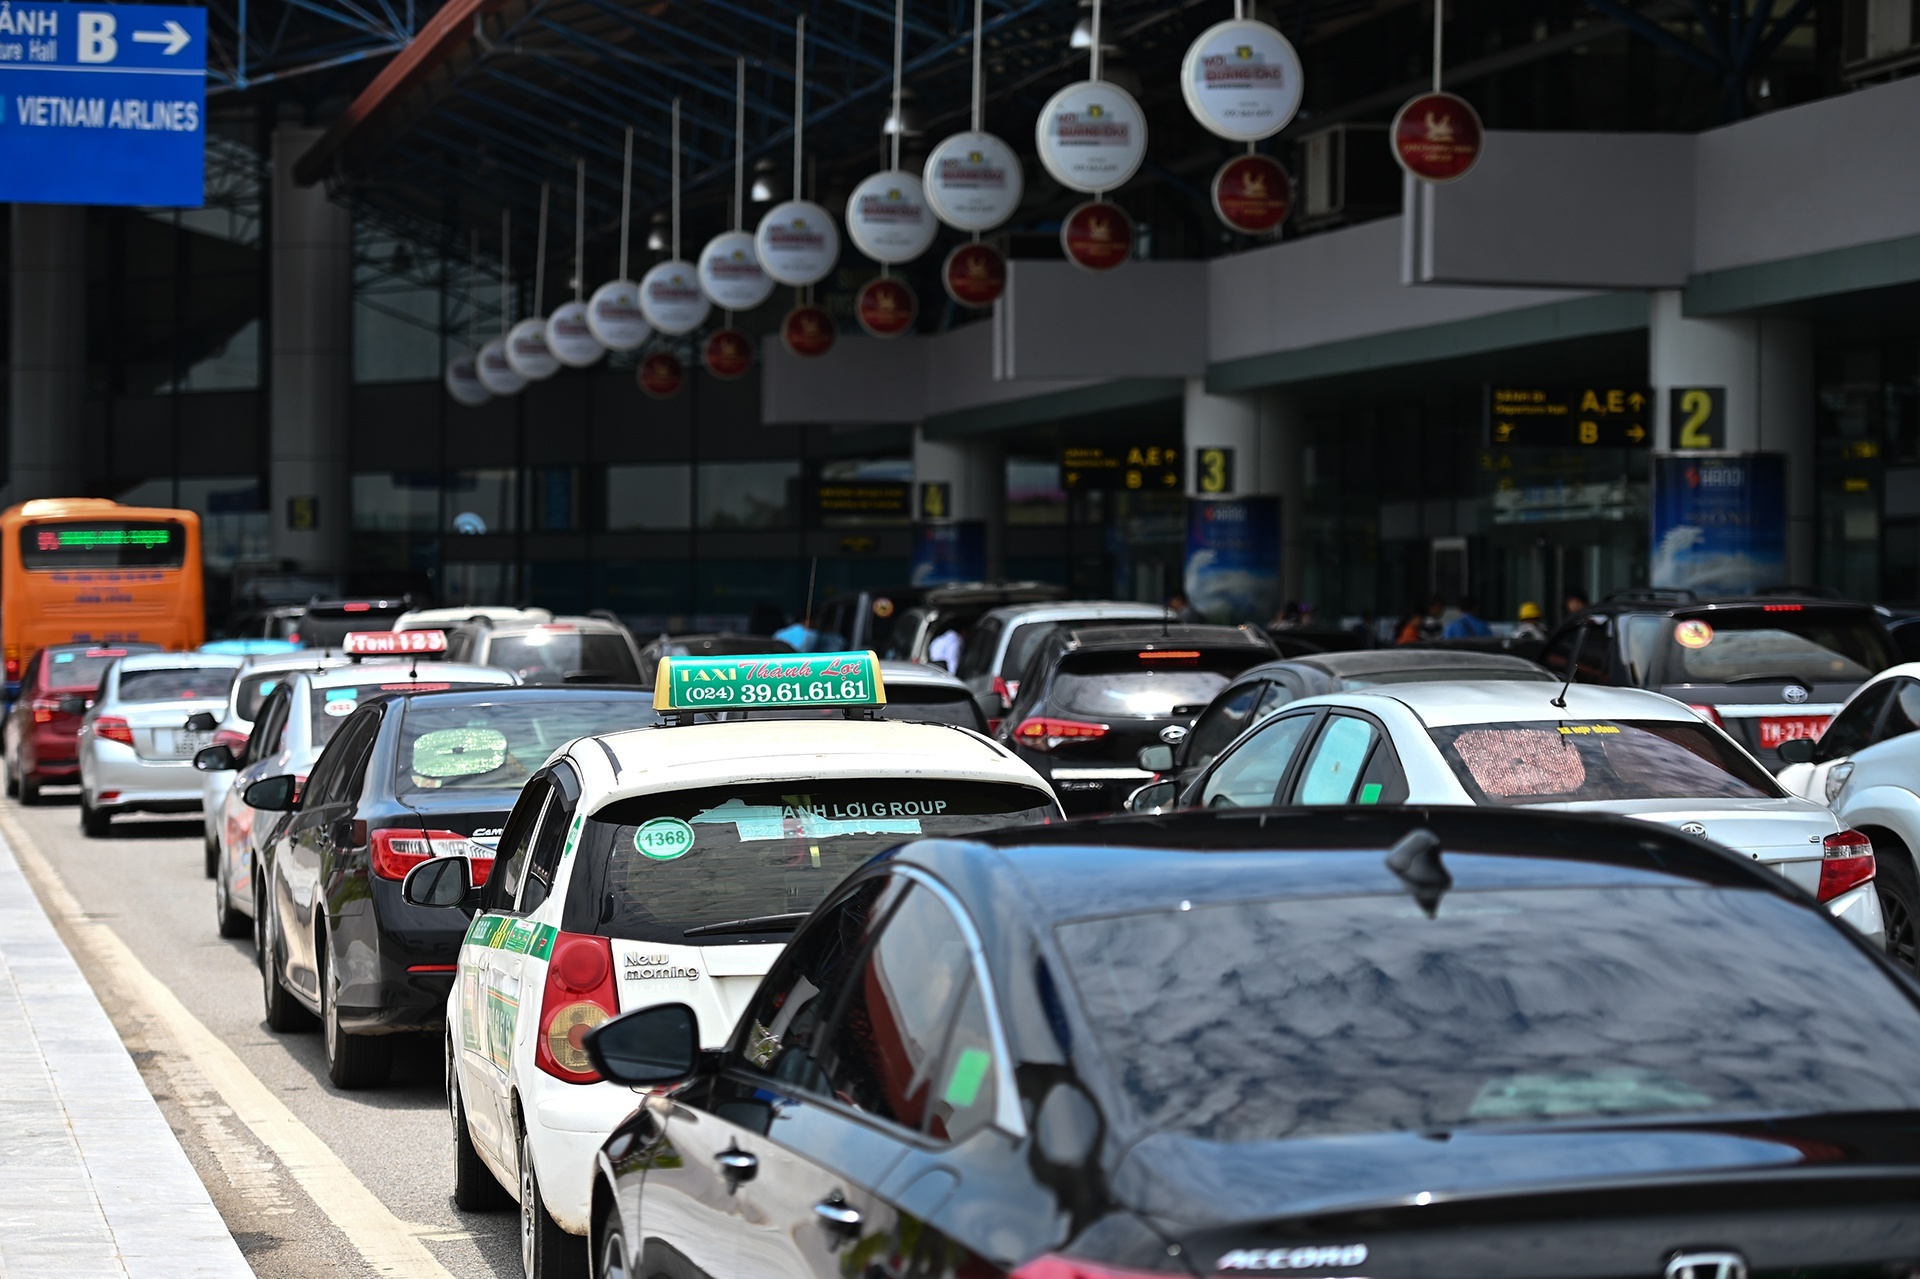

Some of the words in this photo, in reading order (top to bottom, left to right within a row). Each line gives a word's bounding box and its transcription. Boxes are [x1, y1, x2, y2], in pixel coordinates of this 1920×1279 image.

[77, 10, 118, 63] B
[29, 38, 57, 62] Hall
[16, 95, 105, 128] VIETNAM
[107, 98, 200, 132] AIRLINES
[1679, 389, 1712, 448] 2
[1578, 420, 1599, 444] B
[1126, 469, 1143, 490] B
[1201, 449, 1226, 493] 3
[924, 484, 944, 517] 4
[353, 635, 395, 651] Taxi
[399, 632, 442, 650] 123
[677, 667, 737, 682] TAXI
[738, 660, 813, 680] Thành
[820, 657, 862, 681] Lợi
[685, 686, 735, 703] (024)
[740, 680, 867, 703] 39.61.61.61
[872, 800, 947, 816] GROUP
[644, 830, 687, 848] 1368
[624, 951, 670, 967] New
[624, 966, 700, 982] morning
[1216, 1243, 1368, 1270] ACCORD
